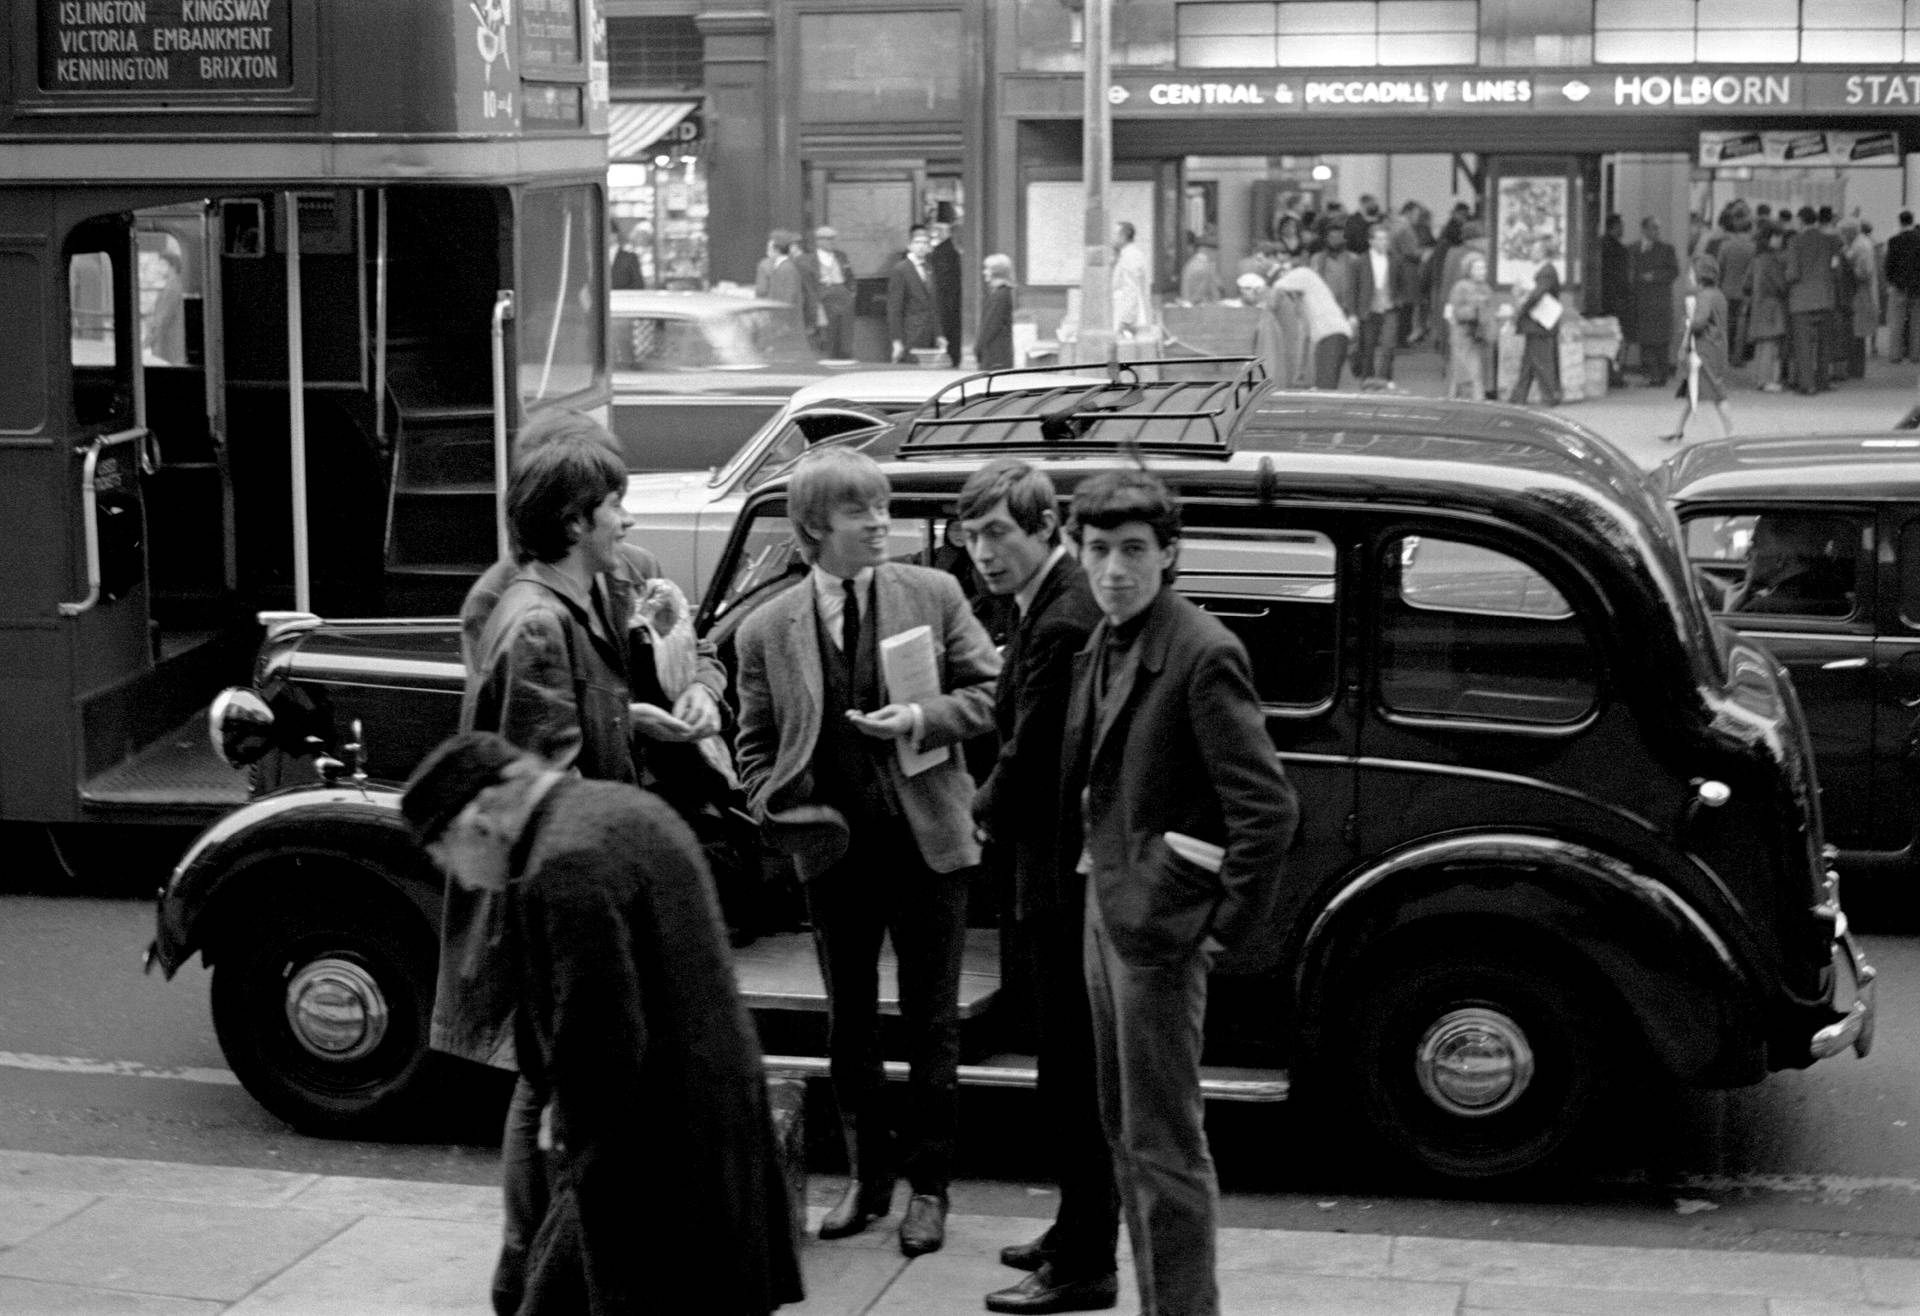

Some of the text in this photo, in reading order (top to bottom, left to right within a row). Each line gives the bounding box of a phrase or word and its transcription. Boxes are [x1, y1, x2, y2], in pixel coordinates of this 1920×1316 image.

[60, 0, 270, 24] ISLINGTON KINGSWAY
[59, 27, 273, 53] VICTORIA EMBANKMENT
[57, 56, 278, 81] KENNINGTON BRIXTON
[1149, 81, 1532, 105] CENTRAL & PICCADILLY LINES
[1613, 75, 1791, 106] HOLBORN
